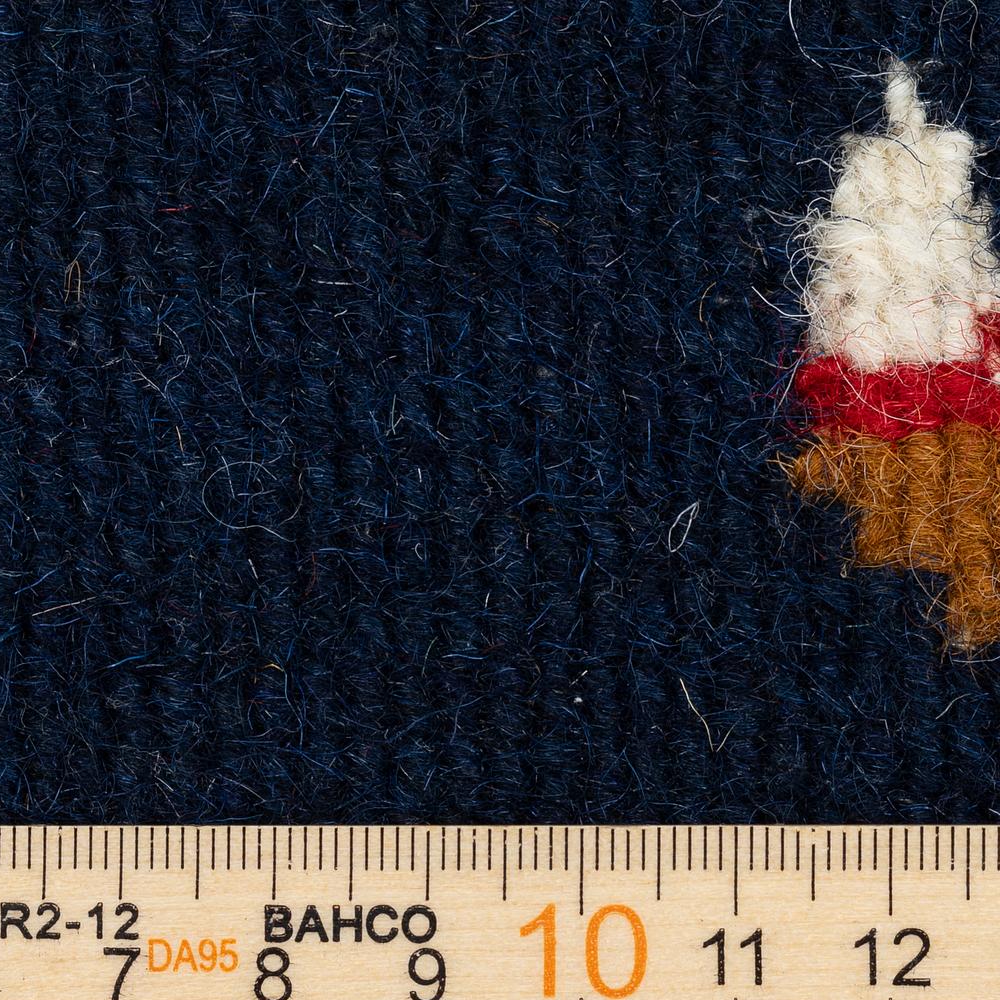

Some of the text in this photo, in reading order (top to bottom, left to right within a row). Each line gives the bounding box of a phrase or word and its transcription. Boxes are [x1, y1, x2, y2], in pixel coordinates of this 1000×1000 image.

[264, 904, 438, 944] BAHCO
[519, 902, 647, 999] 10
[148, 939, 239, 972] DA95
[702, 928, 763, 986] 11
[854, 928, 931, 987] 12
